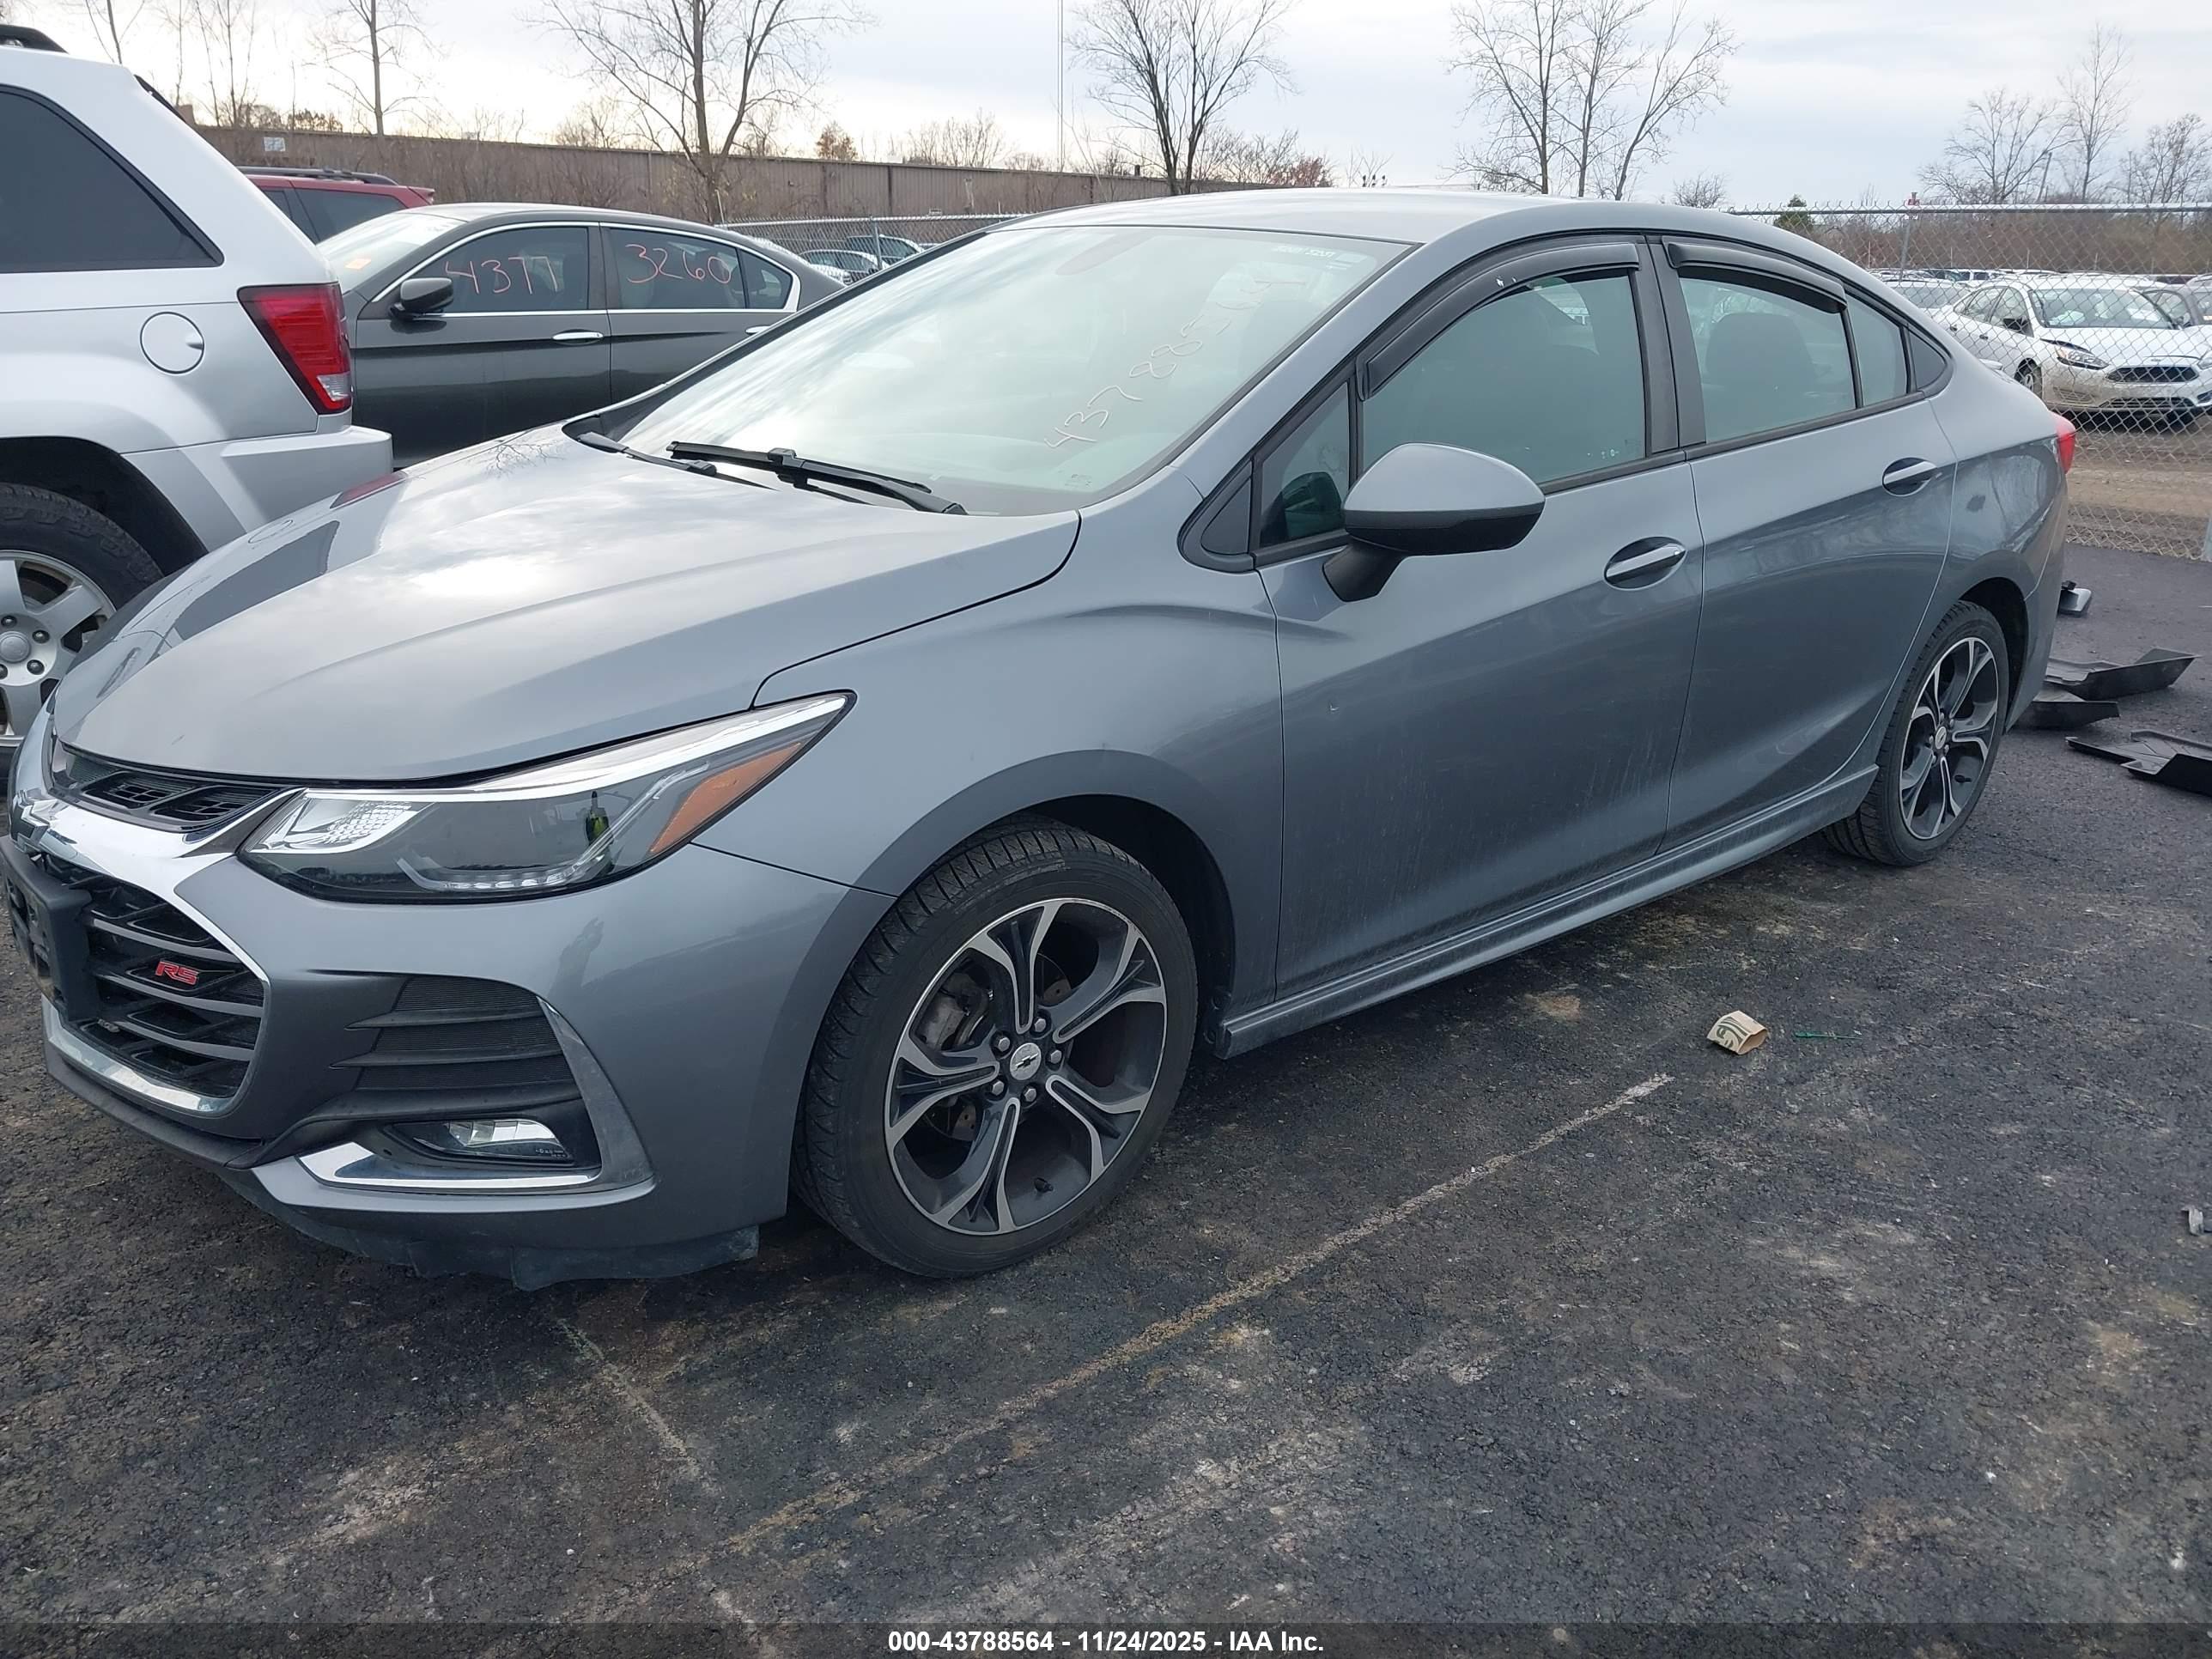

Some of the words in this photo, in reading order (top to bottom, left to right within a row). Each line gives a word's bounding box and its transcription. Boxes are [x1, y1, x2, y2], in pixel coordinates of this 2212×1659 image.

[445, 256, 558, 295] 4377
[625, 244, 732, 283] 3260
[155, 961, 198, 985] RS
